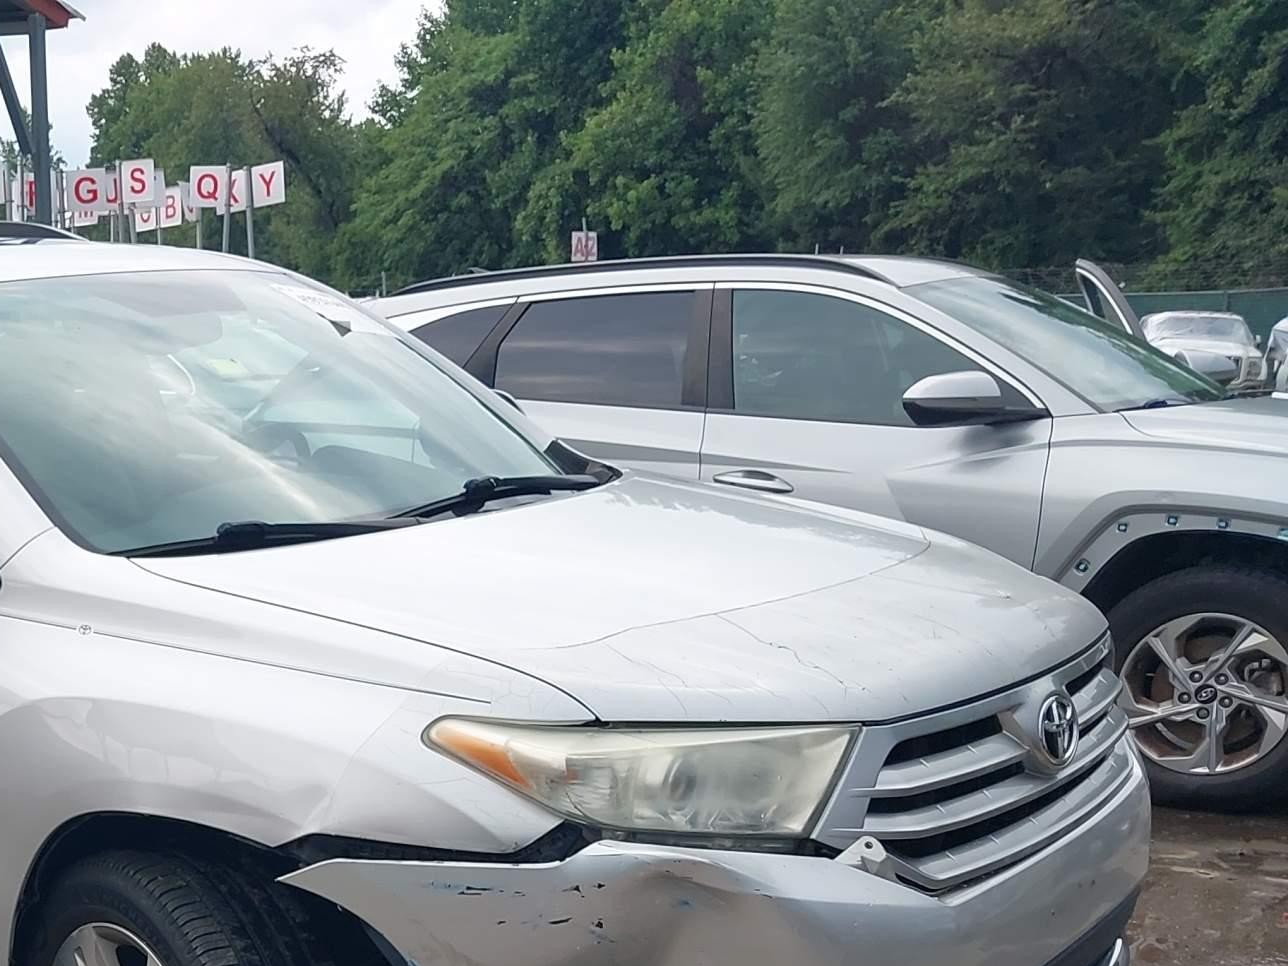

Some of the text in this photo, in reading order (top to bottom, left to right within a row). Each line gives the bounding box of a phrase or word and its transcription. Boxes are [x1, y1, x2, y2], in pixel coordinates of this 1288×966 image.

[74, 176, 99, 204] G
[130, 167, 146, 195] S
[196, 173, 219, 201] Q
[259, 170, 276, 197] Y
[165, 194, 177, 219] B
